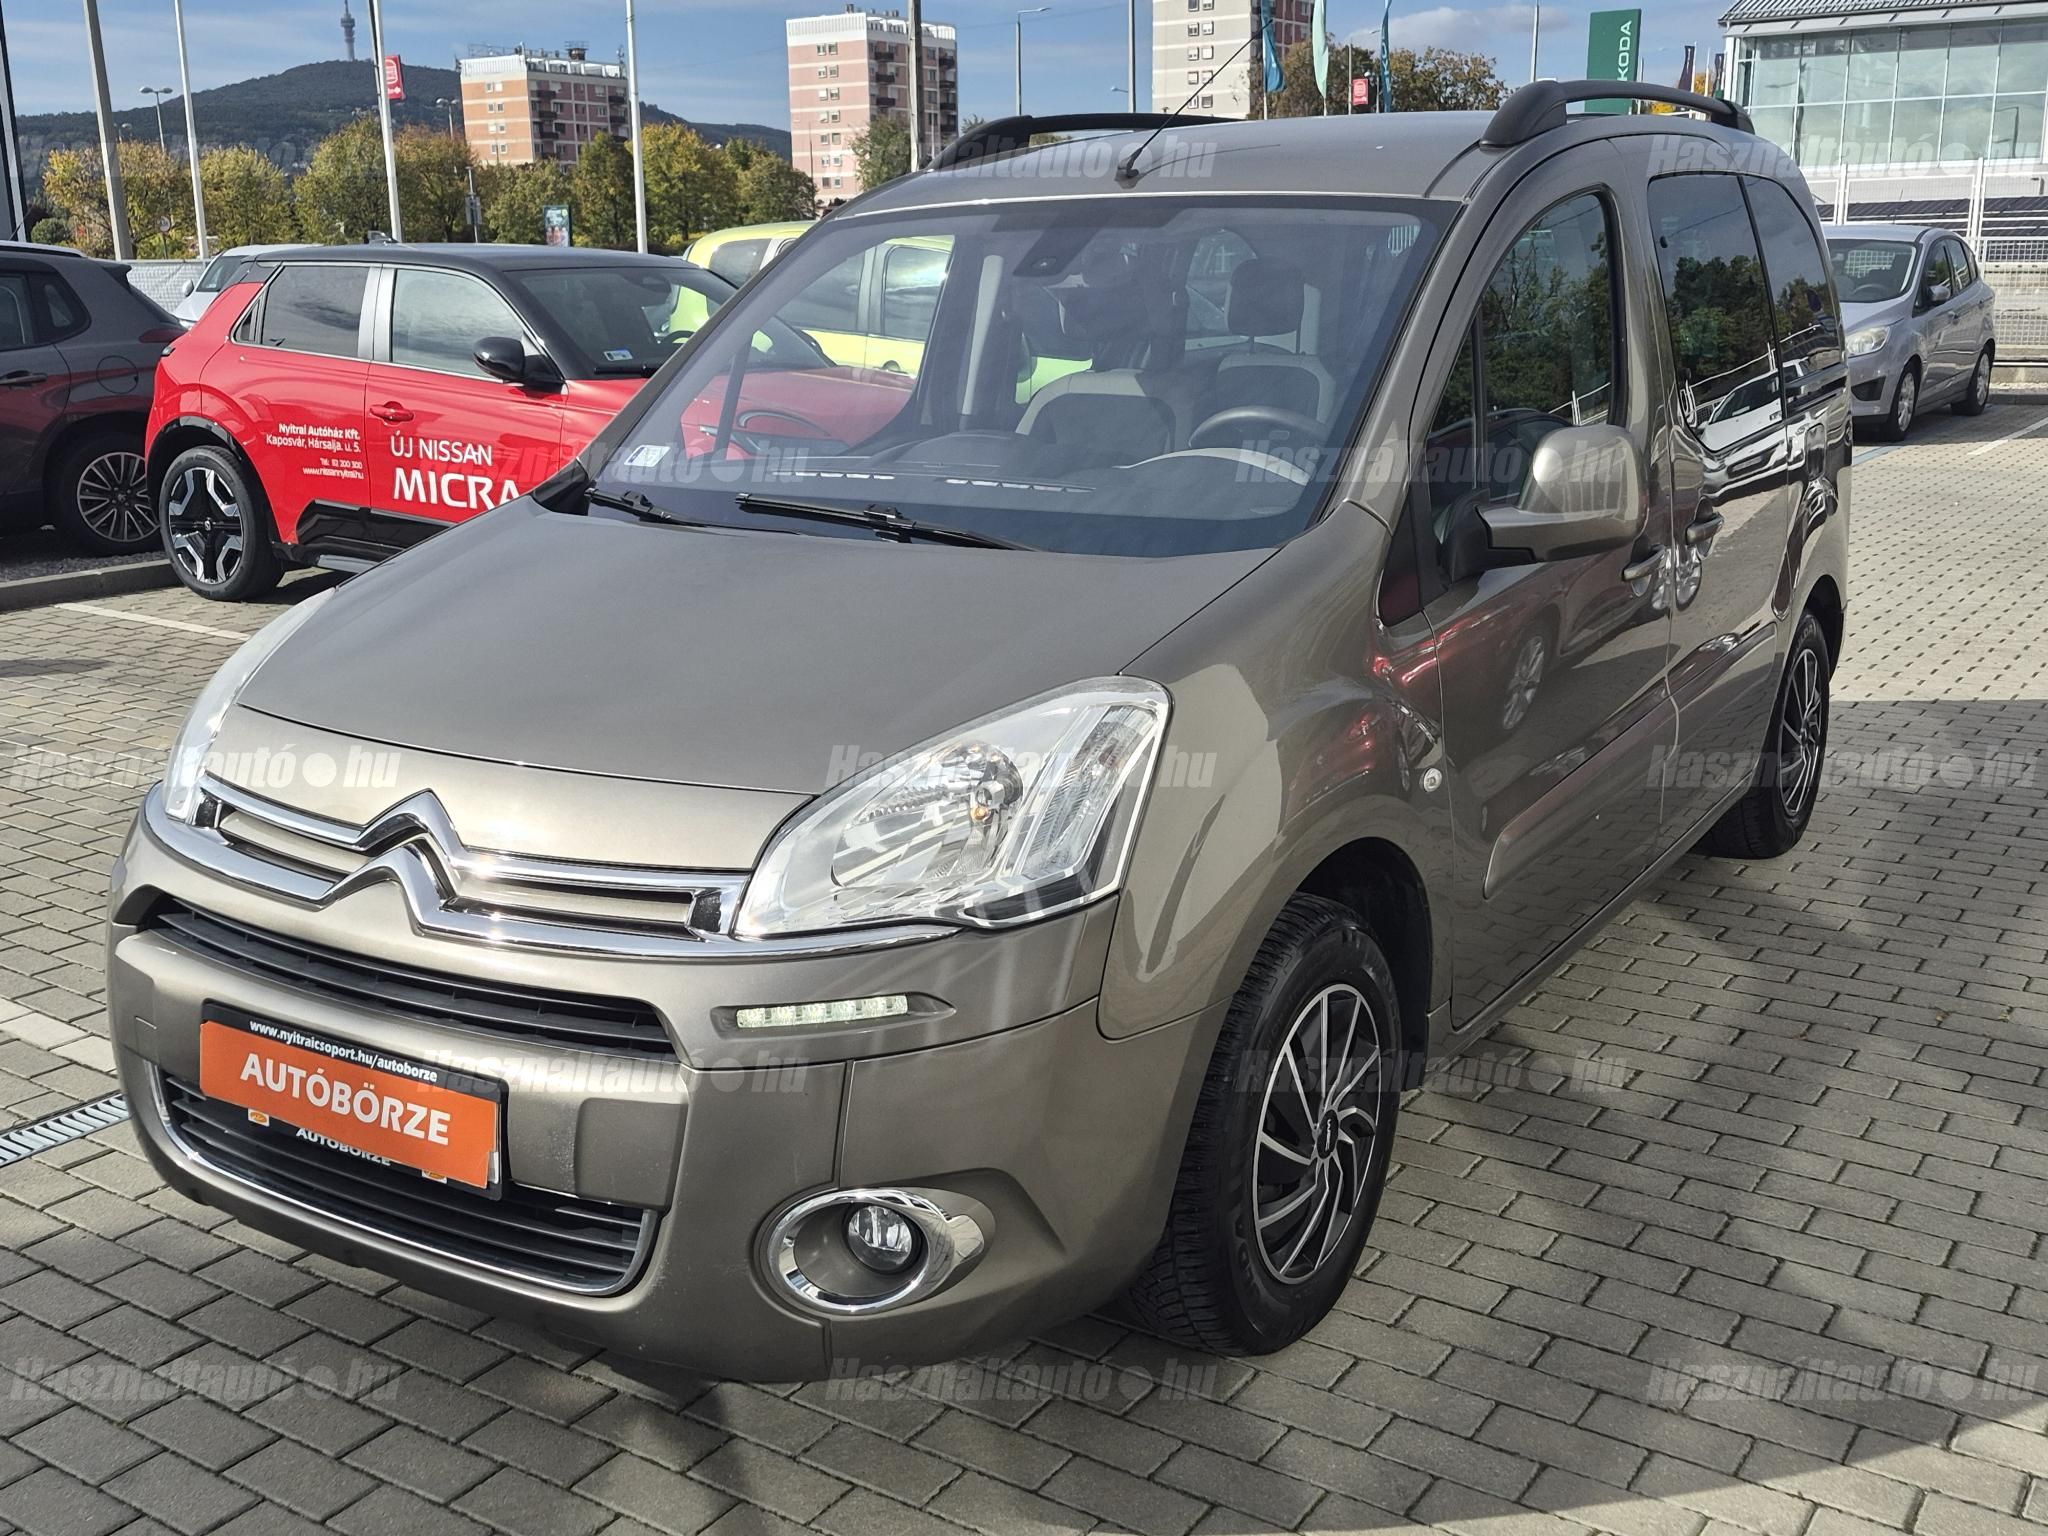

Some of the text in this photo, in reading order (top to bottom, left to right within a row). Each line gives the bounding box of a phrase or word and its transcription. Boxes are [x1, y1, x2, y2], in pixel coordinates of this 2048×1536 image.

[1617, 20, 1632, 81] KODA
[307, 425, 343, 438] Autóház
[390, 430, 492, 466] ÚJ NISSAN
[393, 467, 520, 510] MICRA
[249, 1020, 438, 1083] www.nyitraicsoport.hu/autoborze
[239, 1052, 451, 1146] AUTÓBÖRZE
